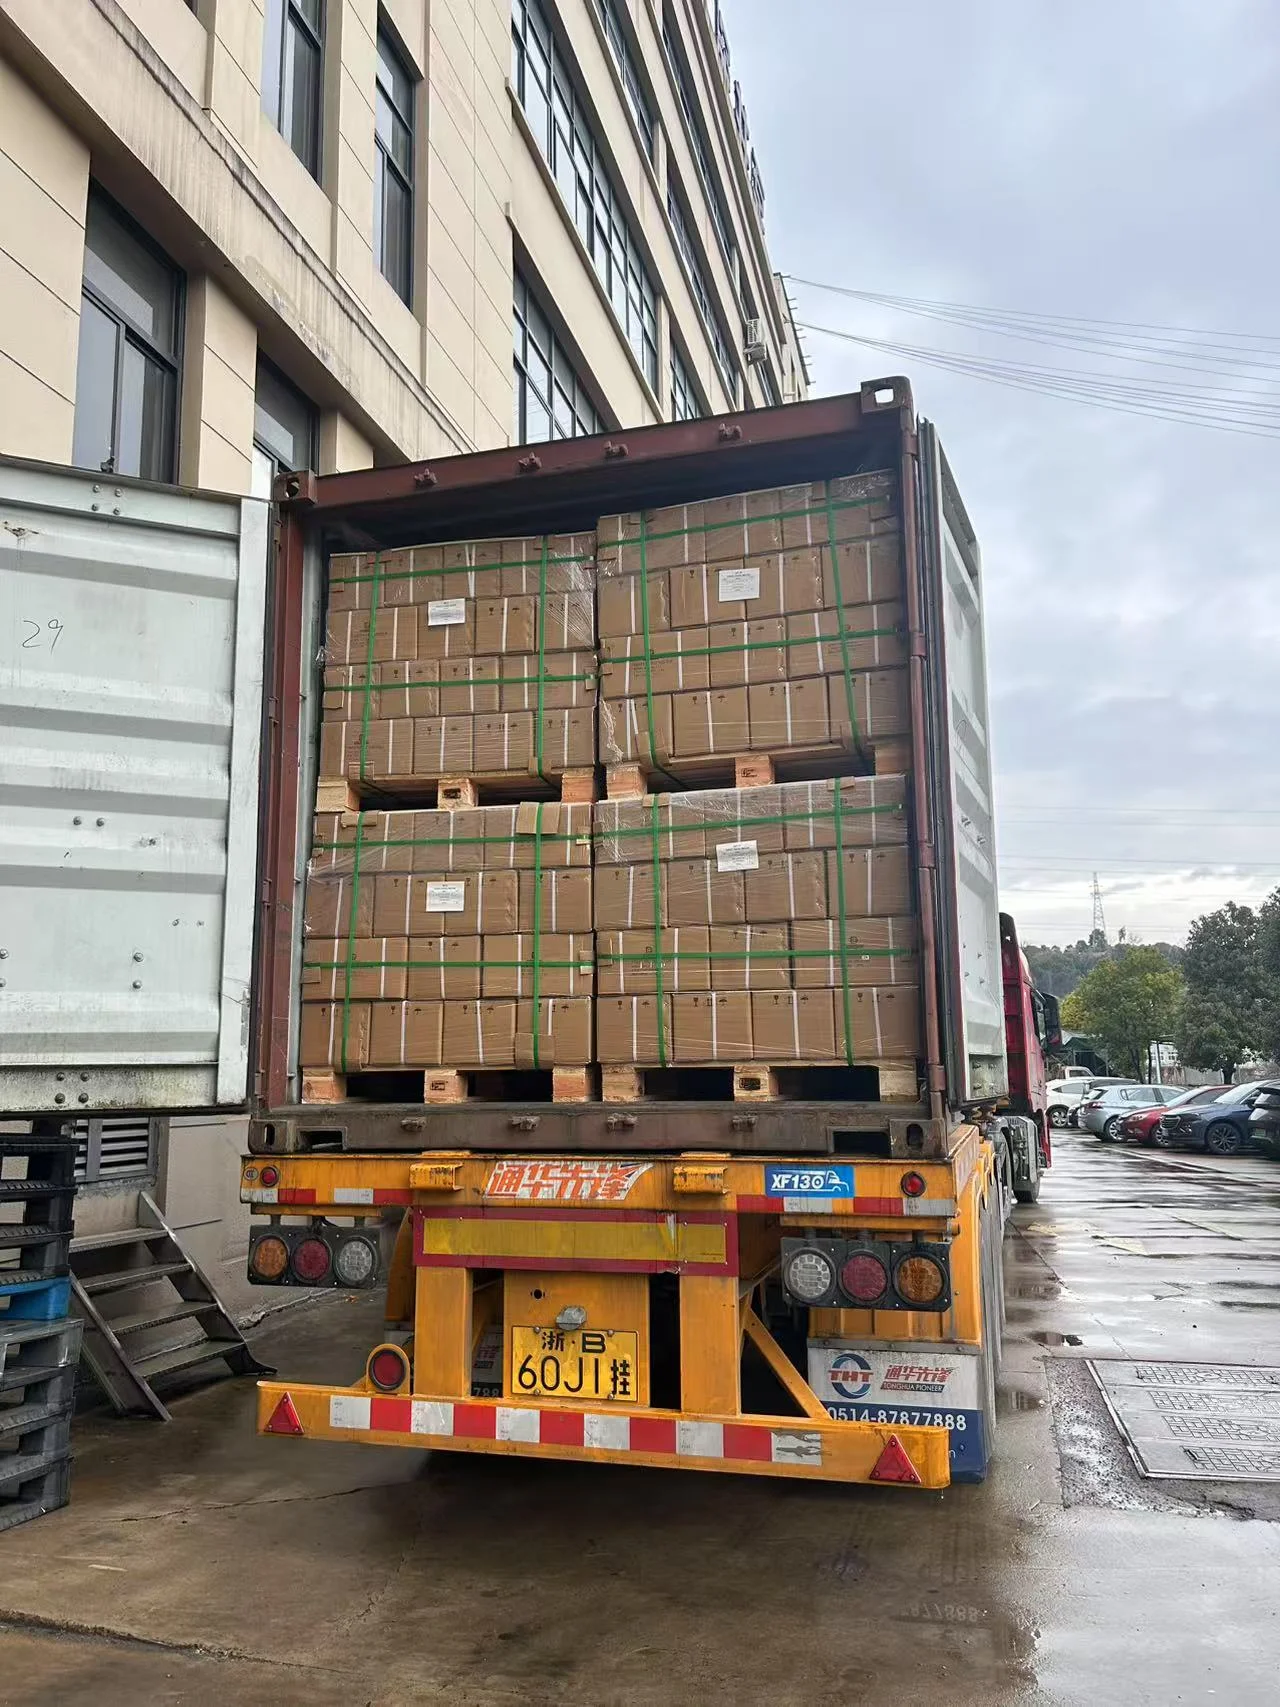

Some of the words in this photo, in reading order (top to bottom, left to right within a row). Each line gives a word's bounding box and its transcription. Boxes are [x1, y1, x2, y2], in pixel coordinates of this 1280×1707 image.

[22, 619, 64, 655] 29
[771, 1174, 825, 1190] XF130
[828, 1370, 874, 1382] THT
[915, 1383, 943, 1392] PIONEER
[827, 1406, 967, 1431] 0514-87877888
